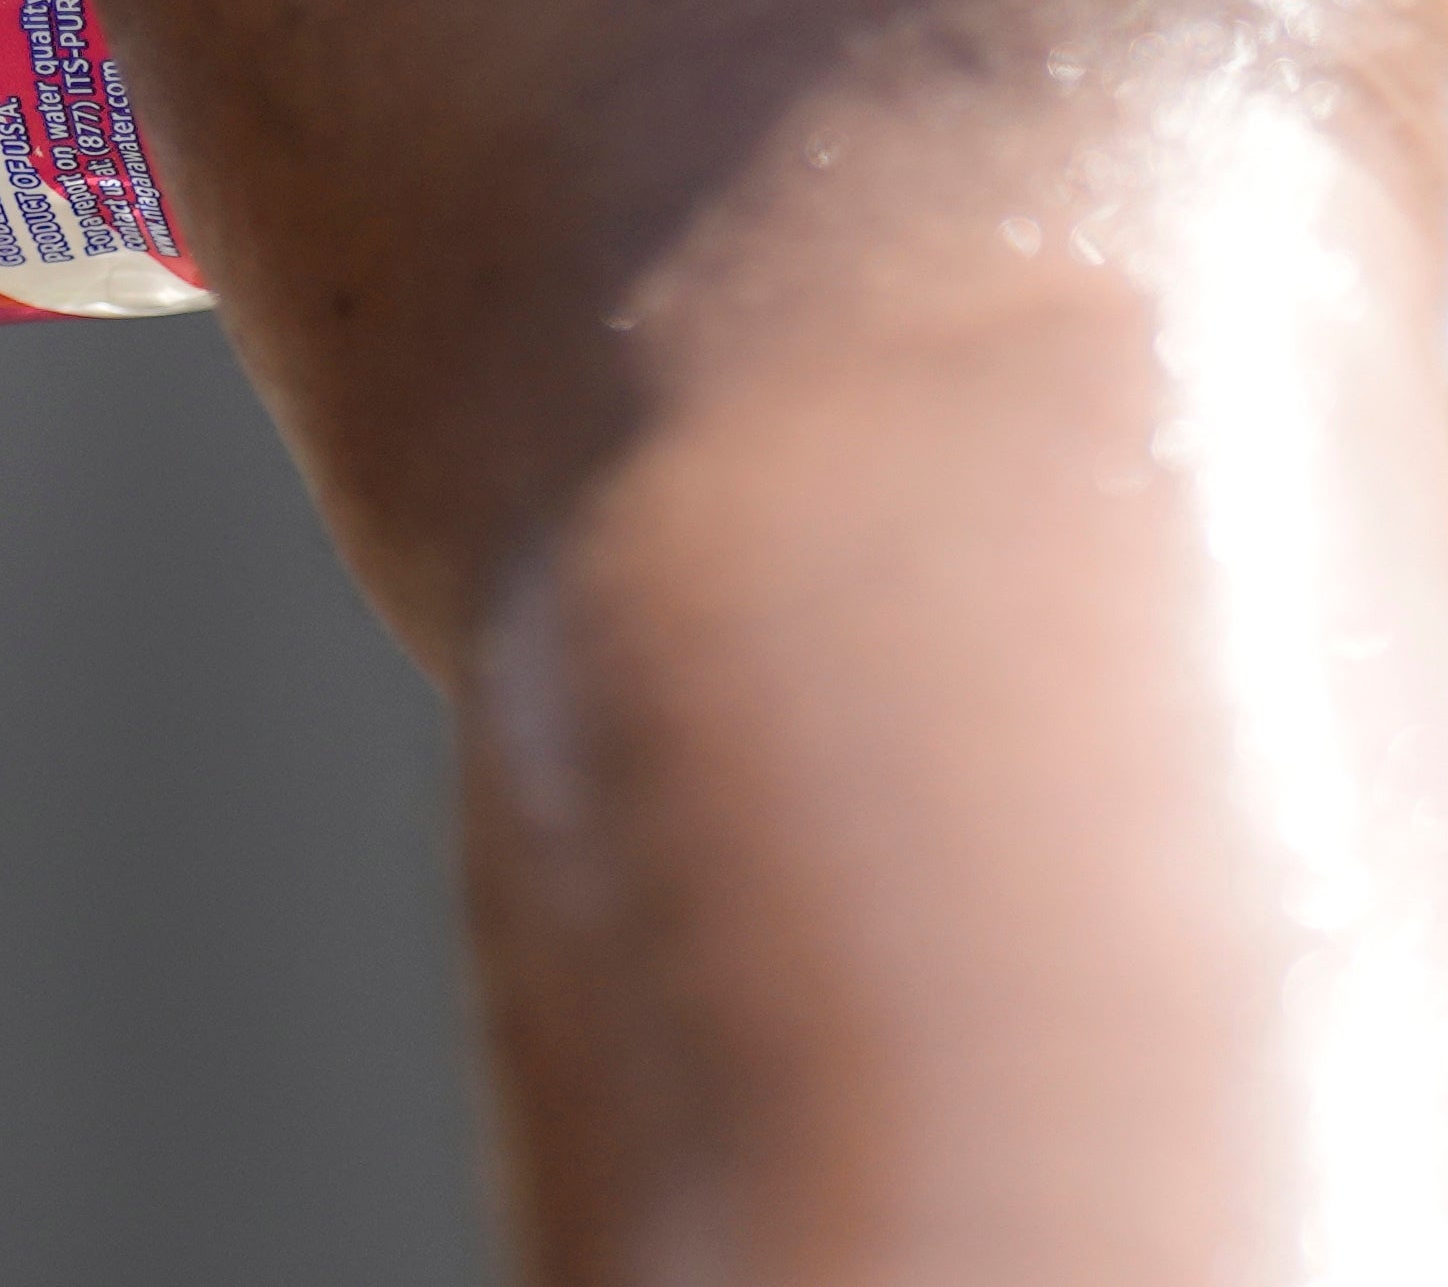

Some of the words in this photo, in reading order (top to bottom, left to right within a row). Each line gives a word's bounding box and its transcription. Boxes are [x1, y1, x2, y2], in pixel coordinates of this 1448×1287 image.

[38, 81, 69, 138] water
[72, 100, 110, 155] (877)
[52, 146, 78, 169] on
[88, 158, 118, 175] at:
[6, 160, 40, 188] OF
[98, 177, 125, 196] us
[57, 173, 99, 215] report
[16, 193, 73, 263] PRODUCT
[82, 215, 104, 227] a
[104, 199, 148, 251] contact
[84, 228, 117, 256] For
